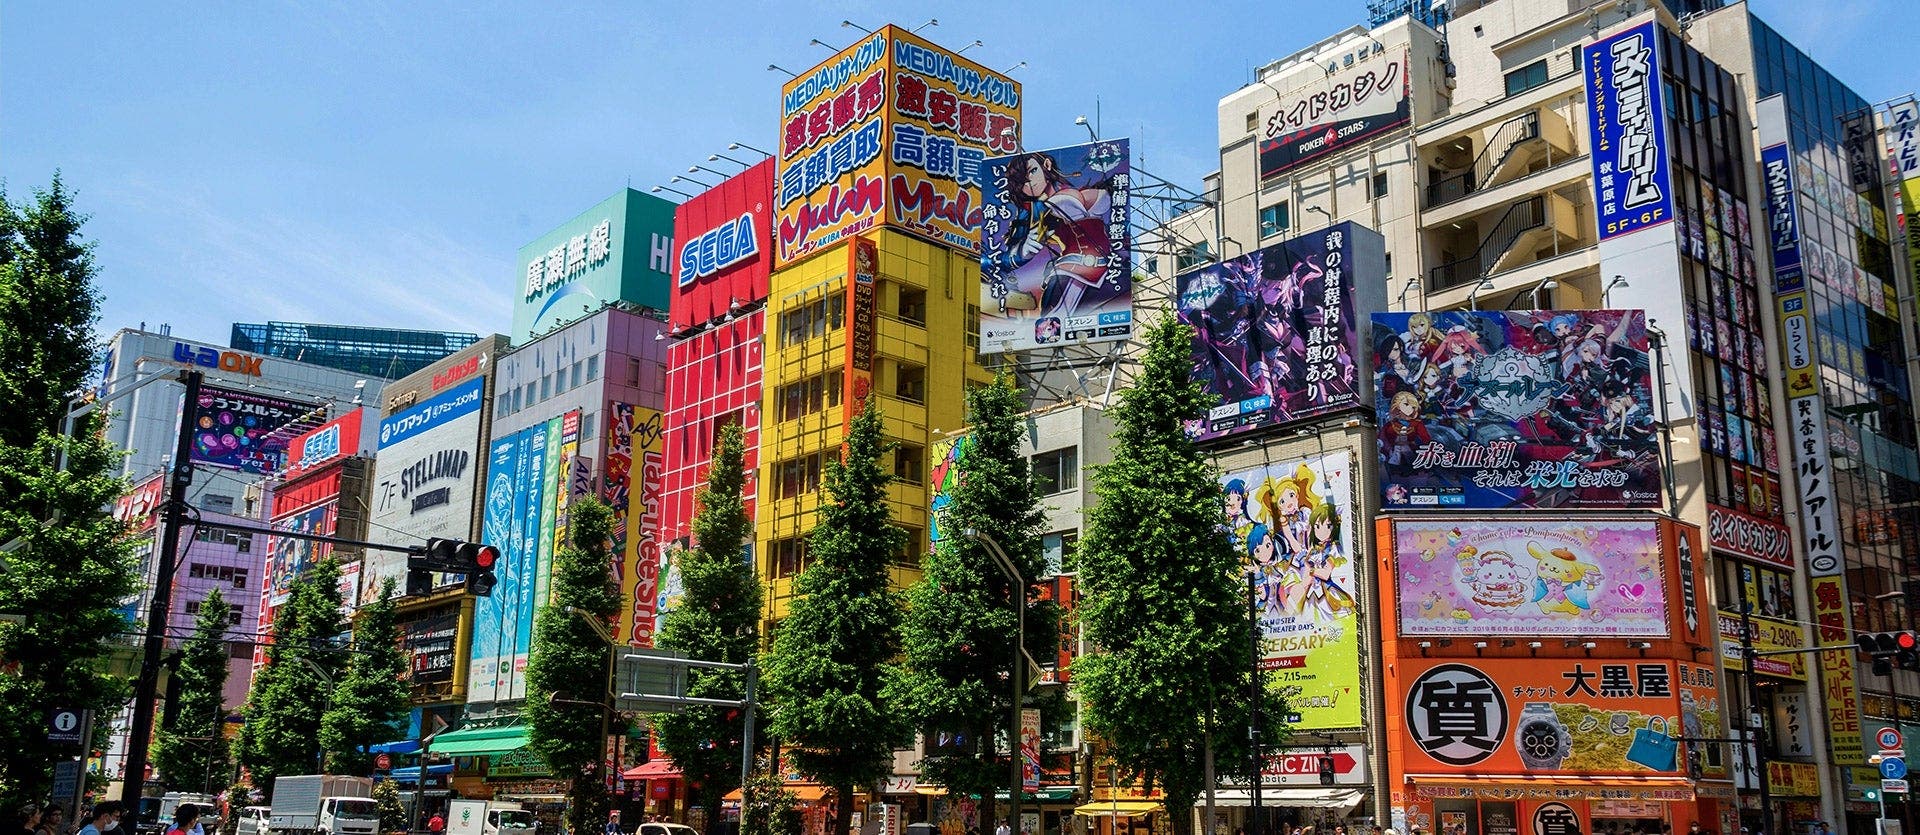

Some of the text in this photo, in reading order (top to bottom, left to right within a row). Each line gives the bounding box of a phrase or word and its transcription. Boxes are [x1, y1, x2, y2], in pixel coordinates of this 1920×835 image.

[784, 33, 886, 118] MEDIAリサイクル
[894, 40, 1018, 108] MEDIAリサイクル
[783, 68, 884, 160] 激安販売
[895, 74, 1016, 154] 激安販売
[1266, 62, 1398, 139] メイドカジノ
[1299, 120, 1364, 154] POKER STARS
[1895, 109, 1919, 173] スーパービル
[780, 117, 882, 208] 高額買取
[992, 164, 1011, 221] いつでも
[1600, 161, 1616, 216] 秋葉原店
[779, 175, 885, 261] Mulan
[905, 217, 944, 238] ムーラン
[944, 233, 973, 249] AKIBA
[1105, 173, 1129, 292] 準備は整ったぞ。
[678, 212, 760, 288] SEGA
[787, 240, 817, 262] ムーラン
[817, 233, 841, 248] AKIBA
[856, 284, 872, 295] DVD
[1786, 300, 1802, 312] 3F
[858, 313, 869, 323] CD
[1790, 318, 1805, 367] りらくる
[1305, 326, 1323, 402] 真理あり
[380, 481, 397, 513] 7F
[401, 449, 468, 499] STELLAMAP
[1472, 460, 1629, 490] それは栄光を求む
[1709, 509, 1789, 561] メイドカジノ
[1269, 623, 1315, 634] THEATER DAYS
[1301, 673, 1316, 681] mon
[1512, 686, 1557, 699] チケット
[1562, 664, 1672, 699] 大黒屋
[1418, 678, 1502, 754] 質
[1842, 686, 1859, 732] FREE
[1882, 734, 1897, 745] 40
[1886, 763, 1896, 777] P
